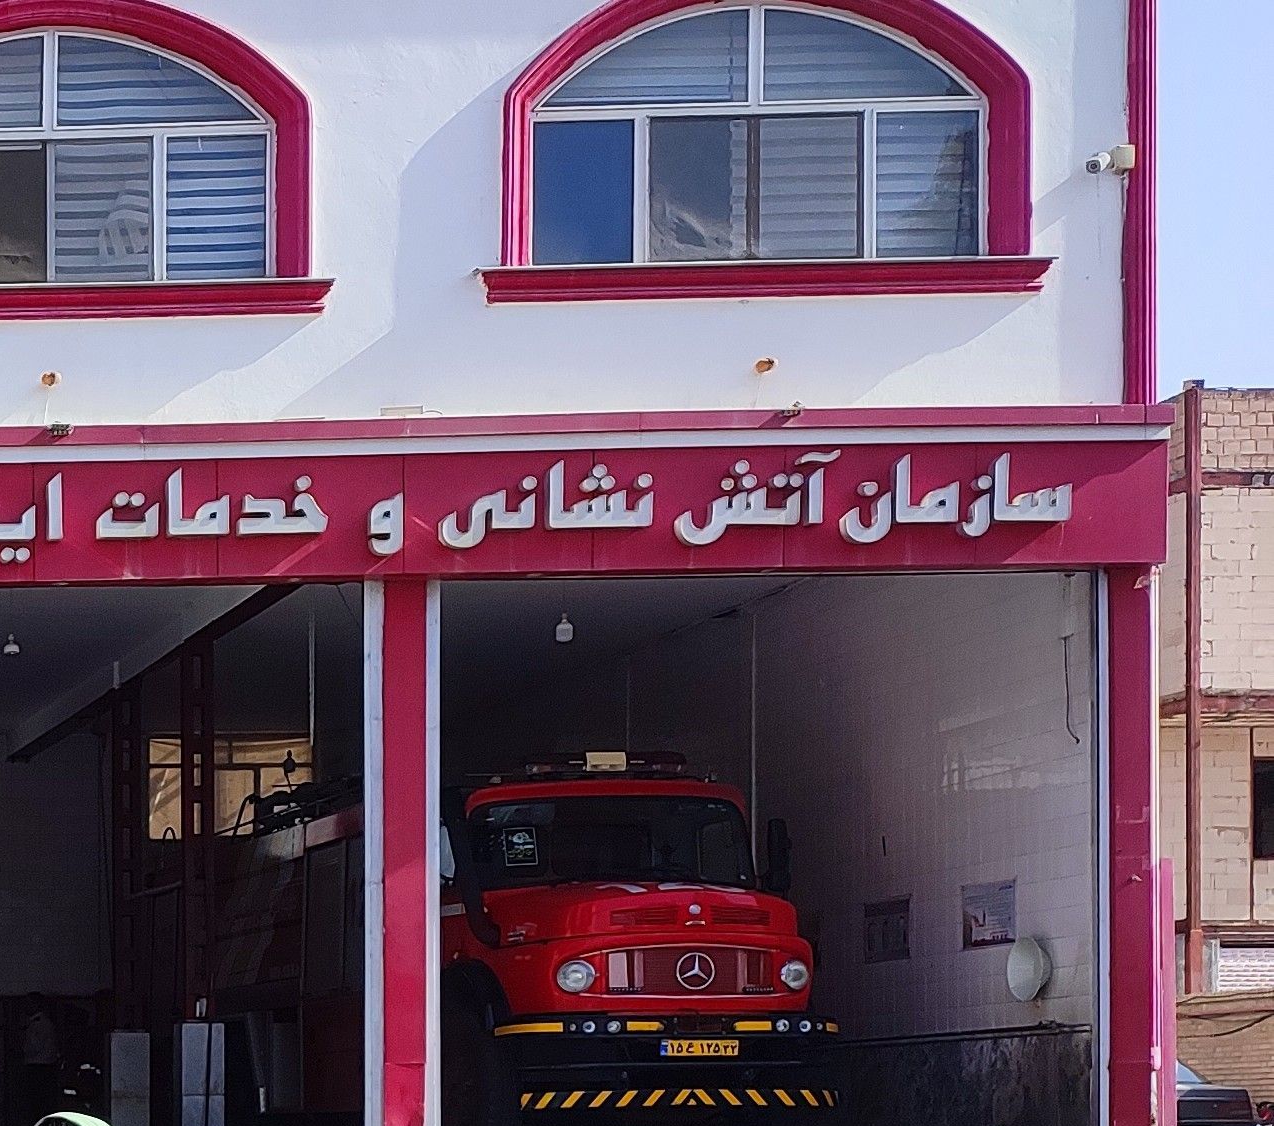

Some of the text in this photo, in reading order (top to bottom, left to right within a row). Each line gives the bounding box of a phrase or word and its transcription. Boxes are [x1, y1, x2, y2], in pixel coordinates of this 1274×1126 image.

[95, 466, 329, 540] خدمات
[367, 490, 404, 557] و
[437, 458, 654, 549] نشانی
[674, 448, 841, 546] آتش
[839, 451, 1073, 546] سازمان
